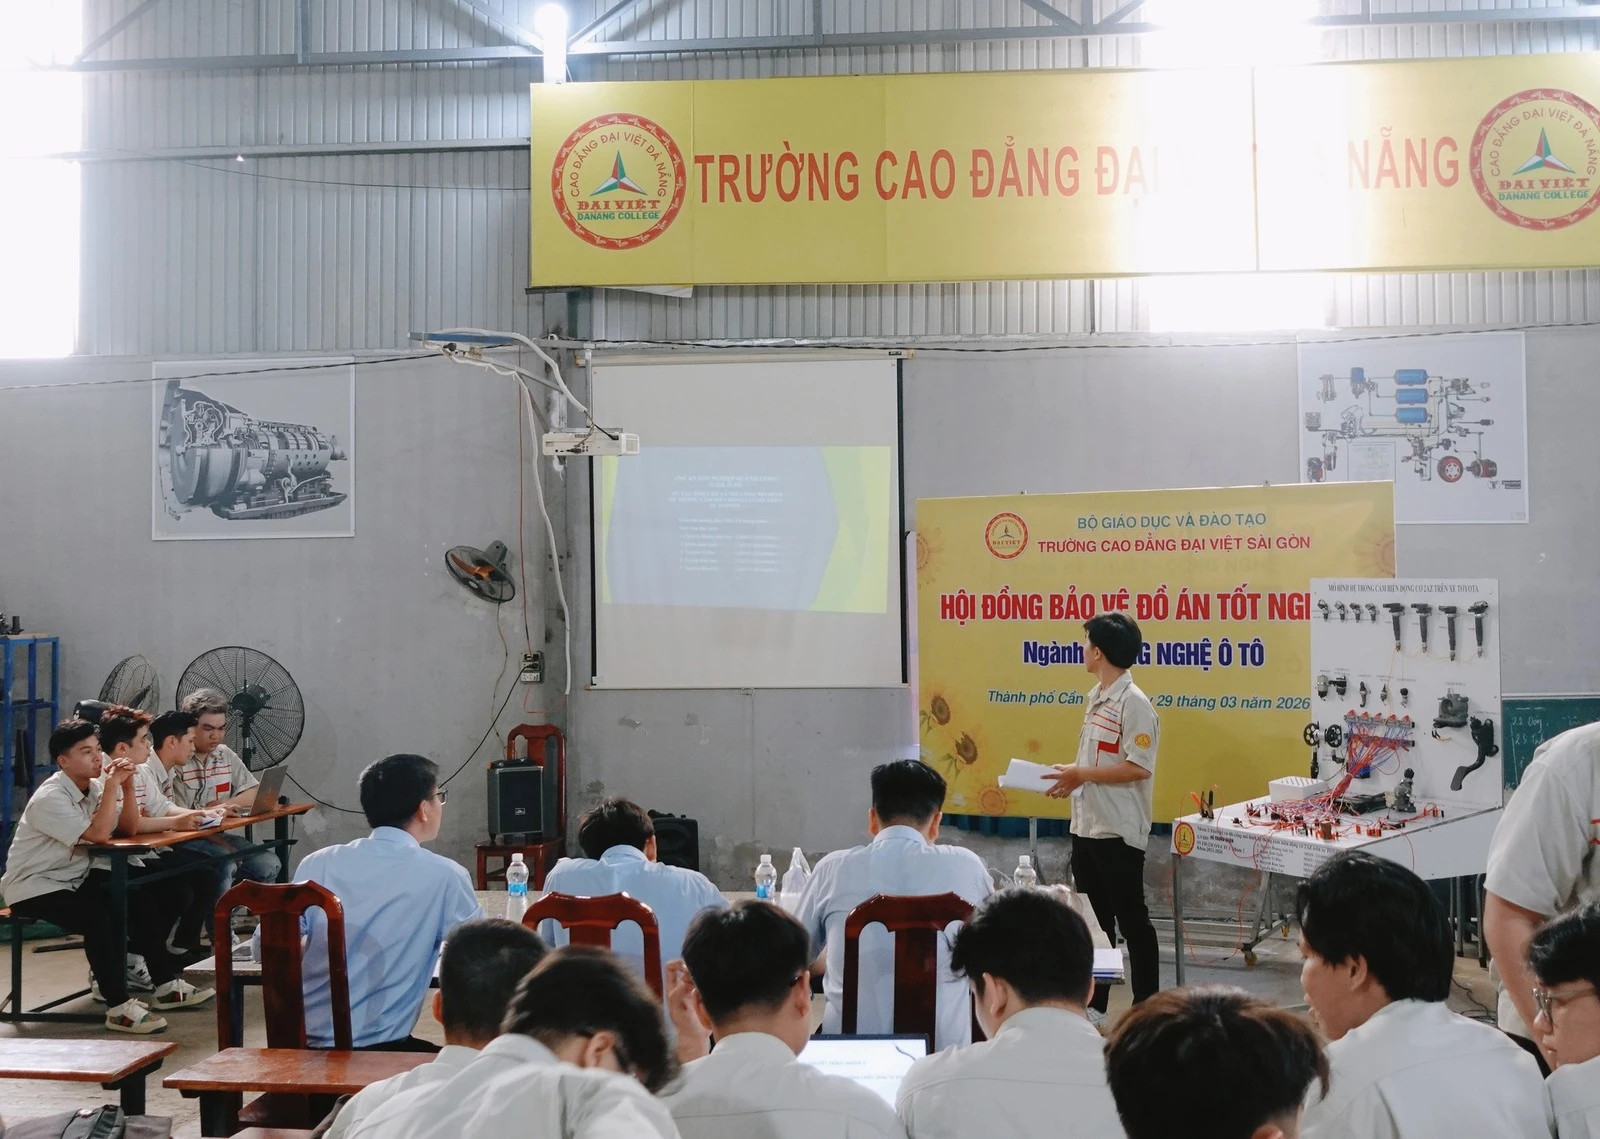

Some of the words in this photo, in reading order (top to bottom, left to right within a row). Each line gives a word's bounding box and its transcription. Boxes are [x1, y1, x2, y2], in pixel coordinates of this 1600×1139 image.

[570, 172, 580, 198] CAO
[600, 132, 620, 144] ĐẠI
[624, 132, 648, 148] VIỆT
[646, 144, 663, 162] ĐÀ
[694, 141, 859, 203] TRƯỜNG
[875, 148, 956, 201] CAO
[969, 135, 1080, 198] ĐẲNG
[1347, 125, 1460, 190] NẴNG
[1490, 150, 1500, 177] CAO
[1499, 191, 1541, 201] DANANG
[1543, 190, 1590, 200] COLLEGE
[577, 212, 616, 221] DANANG
[618, 211, 660, 220] COLLEGE
[1077, 515, 1098, 531] BỘ
[1101, 513, 1137, 529] GIÁO
[1140, 515, 1171, 532] DỤC
[1176, 511, 1196, 527] VÀ
[1199, 510, 1232, 527] ĐÀO
[1235, 512, 1267, 528] TẠO
[1038, 537, 1097, 553] TRƯỜNG
[1101, 540, 1131, 553] CAO
[1134, 533, 1177, 552] ĐẲNG
[1180, 538, 1205, 553] ĐẠI
[1209, 535, 1243, 553] VIỆT
[1247, 534, 1271, 550] SÀI
[1275, 533, 1311, 550] GÒN
[941, 588, 976, 625] HỘI
[981, 585, 1043, 620] ĐỒNG
[1049, 585, 1096, 620] BẢO
[1136, 584, 1168, 620] ĐỒ
[1175, 588, 1211, 620] ÁN
[1216, 583, 1262, 620] TỐT
[1023, 641, 1084, 667] Ngành
[1156, 637, 1213, 671] NGHỆ
[1217, 637, 1233, 666] Ô
[1237, 637, 1265, 666] TÔ
[987, 690, 1027, 704] Thành
[1029, 689, 1055, 707] phố
[1057, 688, 1084, 705] Cần
[1156, 694, 1174, 707] 29
[1176, 693, 1217, 710] tháng
[1219, 696, 1238, 708] 03
[1240, 694, 1272, 709] năm
[1276, 696, 1311, 710] 2026
